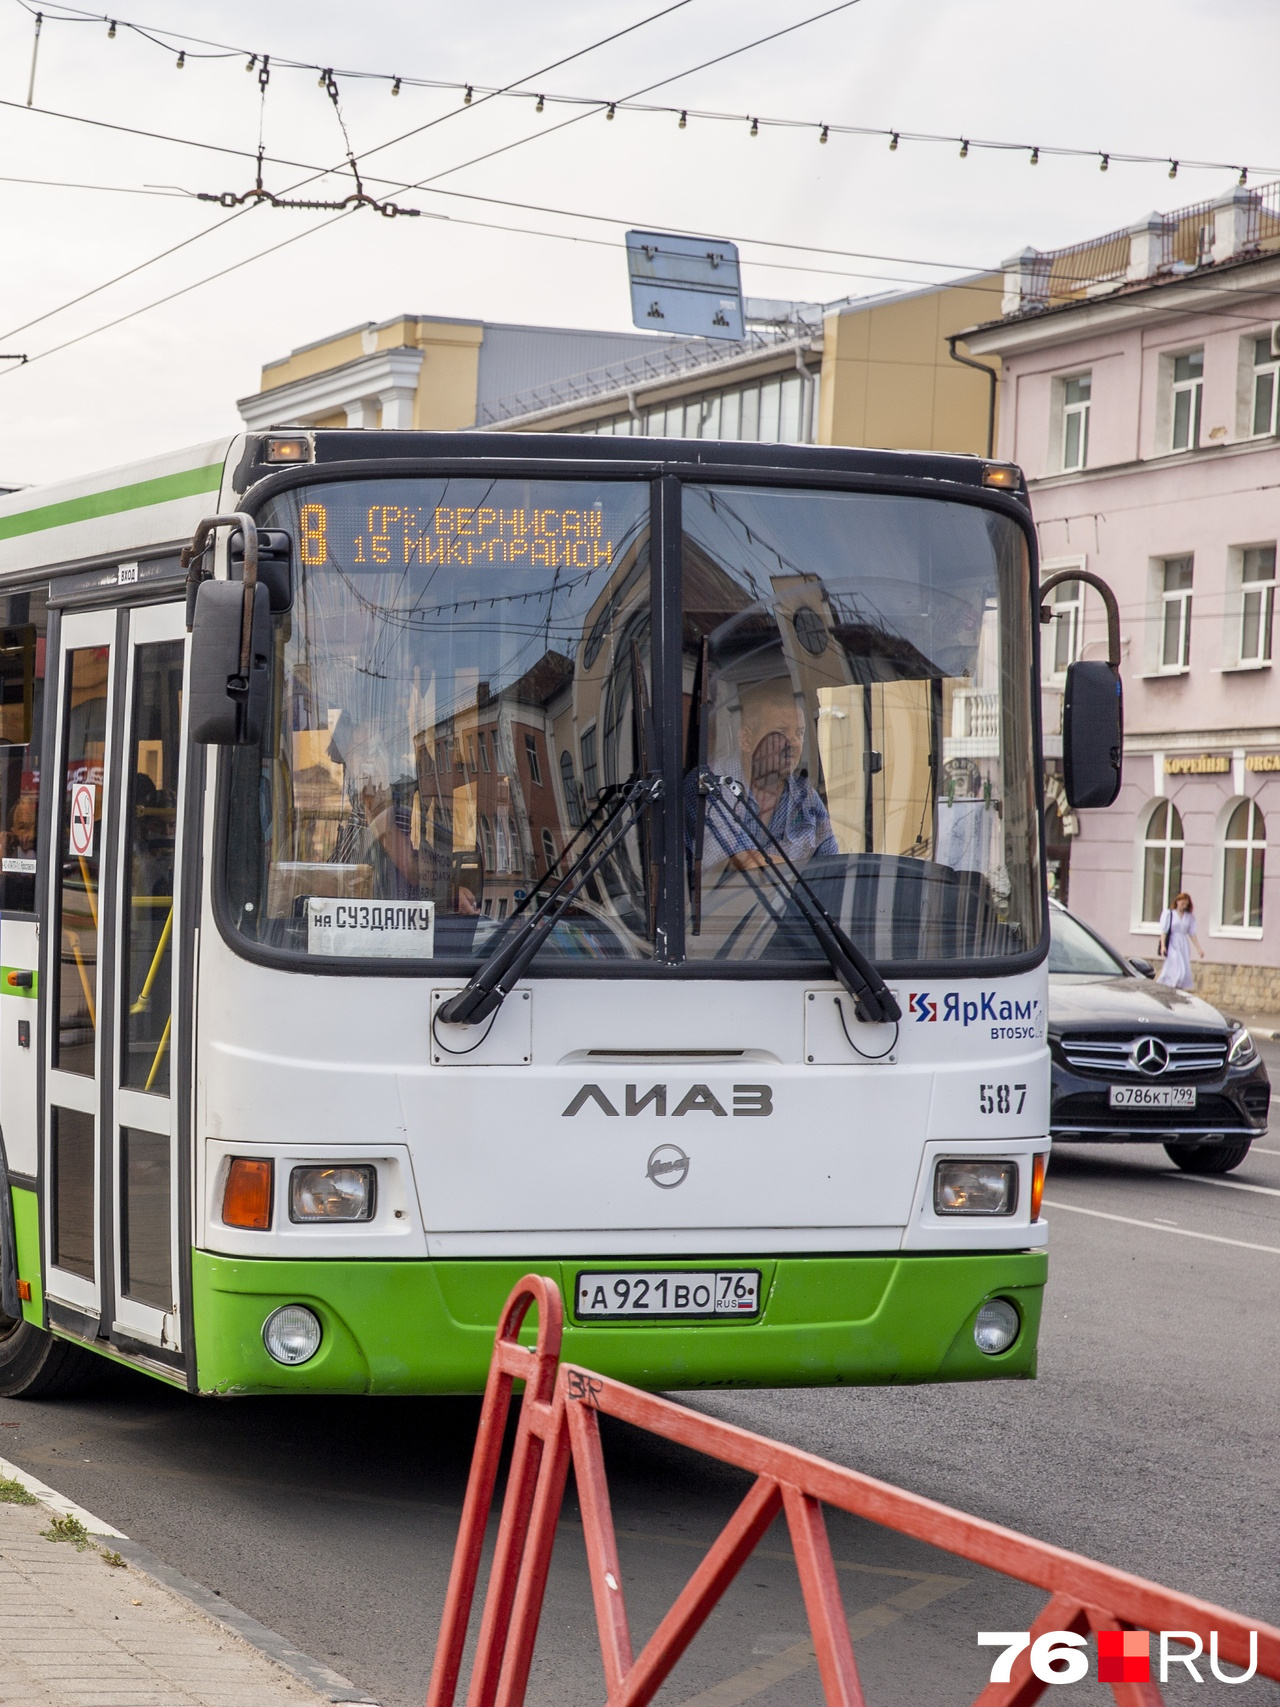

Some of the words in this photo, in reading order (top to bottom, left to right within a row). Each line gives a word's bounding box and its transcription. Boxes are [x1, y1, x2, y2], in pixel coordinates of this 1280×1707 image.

[300, 504, 327, 565] 8
[434, 507, 602, 538] ВЕРНИСАЖ
[354, 535, 391, 563] 15
[1164, 754, 1231, 774] КОФЕЙНЯ
[336, 906, 430, 931] СУЗДАЛКУ
[942, 991, 1039, 1027] ЯрКам
[561, 1084, 774, 1117] ЛИАЗ
[980, 1084, 1027, 1115] 587
[1115, 1088, 1170, 1104] О786КТ
[1173, 1088, 1193, 1102] 799
[591, 1278, 711, 1310] А921ВО
[719, 1276, 747, 1300] 76
[716, 1299, 738, 1309] RUS
